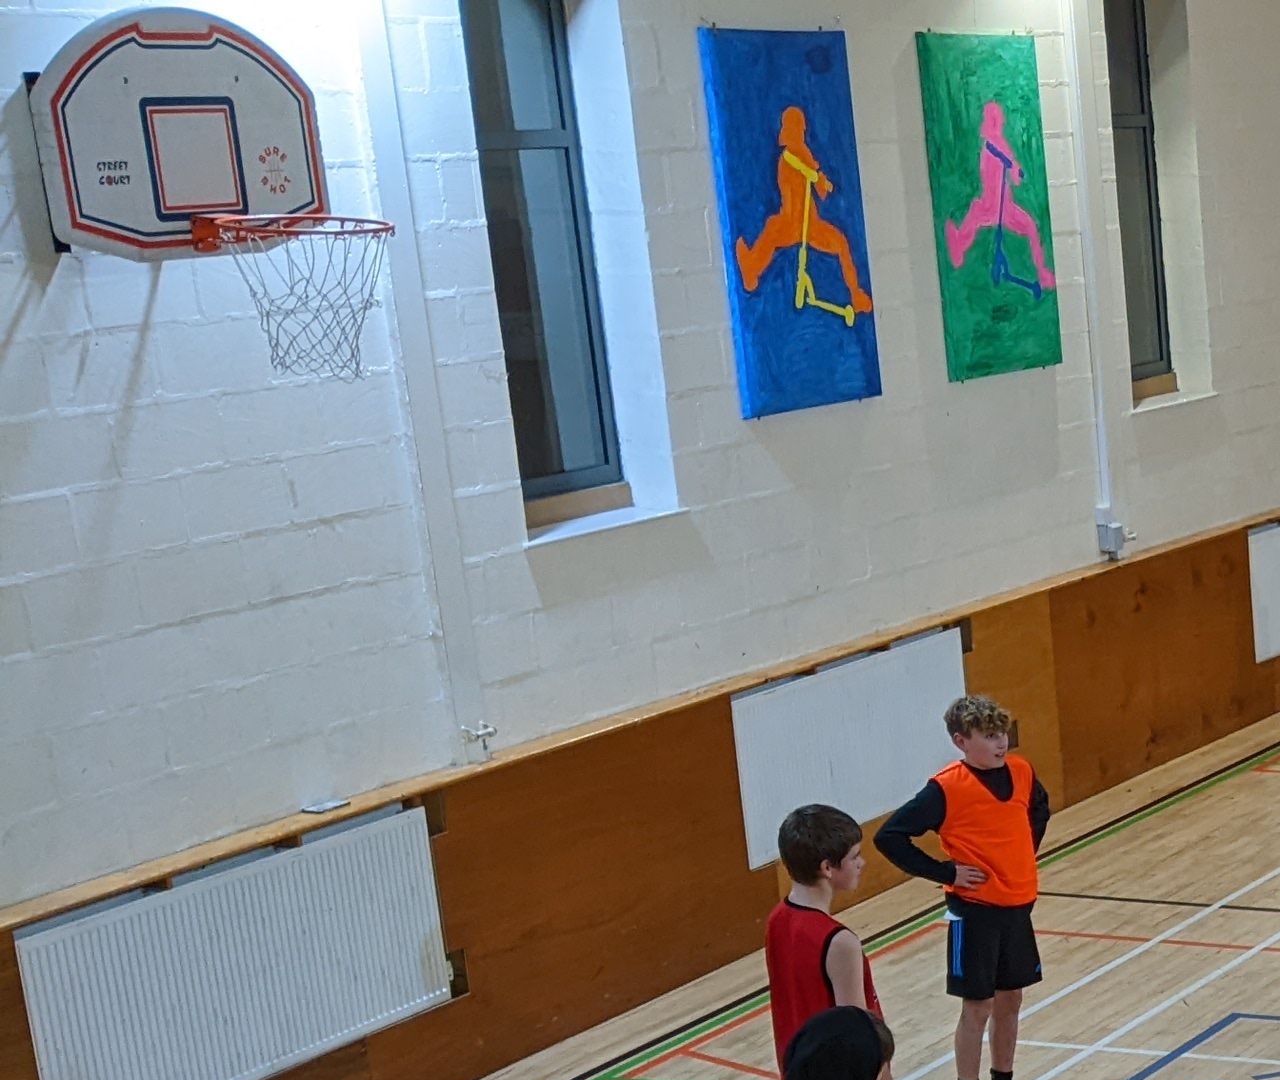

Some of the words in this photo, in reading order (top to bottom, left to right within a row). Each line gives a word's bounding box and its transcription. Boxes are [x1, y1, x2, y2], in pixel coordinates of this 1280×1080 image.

[258, 146, 288, 165] SURE
[97, 161, 129, 172] STREET
[99, 175, 131, 186] COURT
